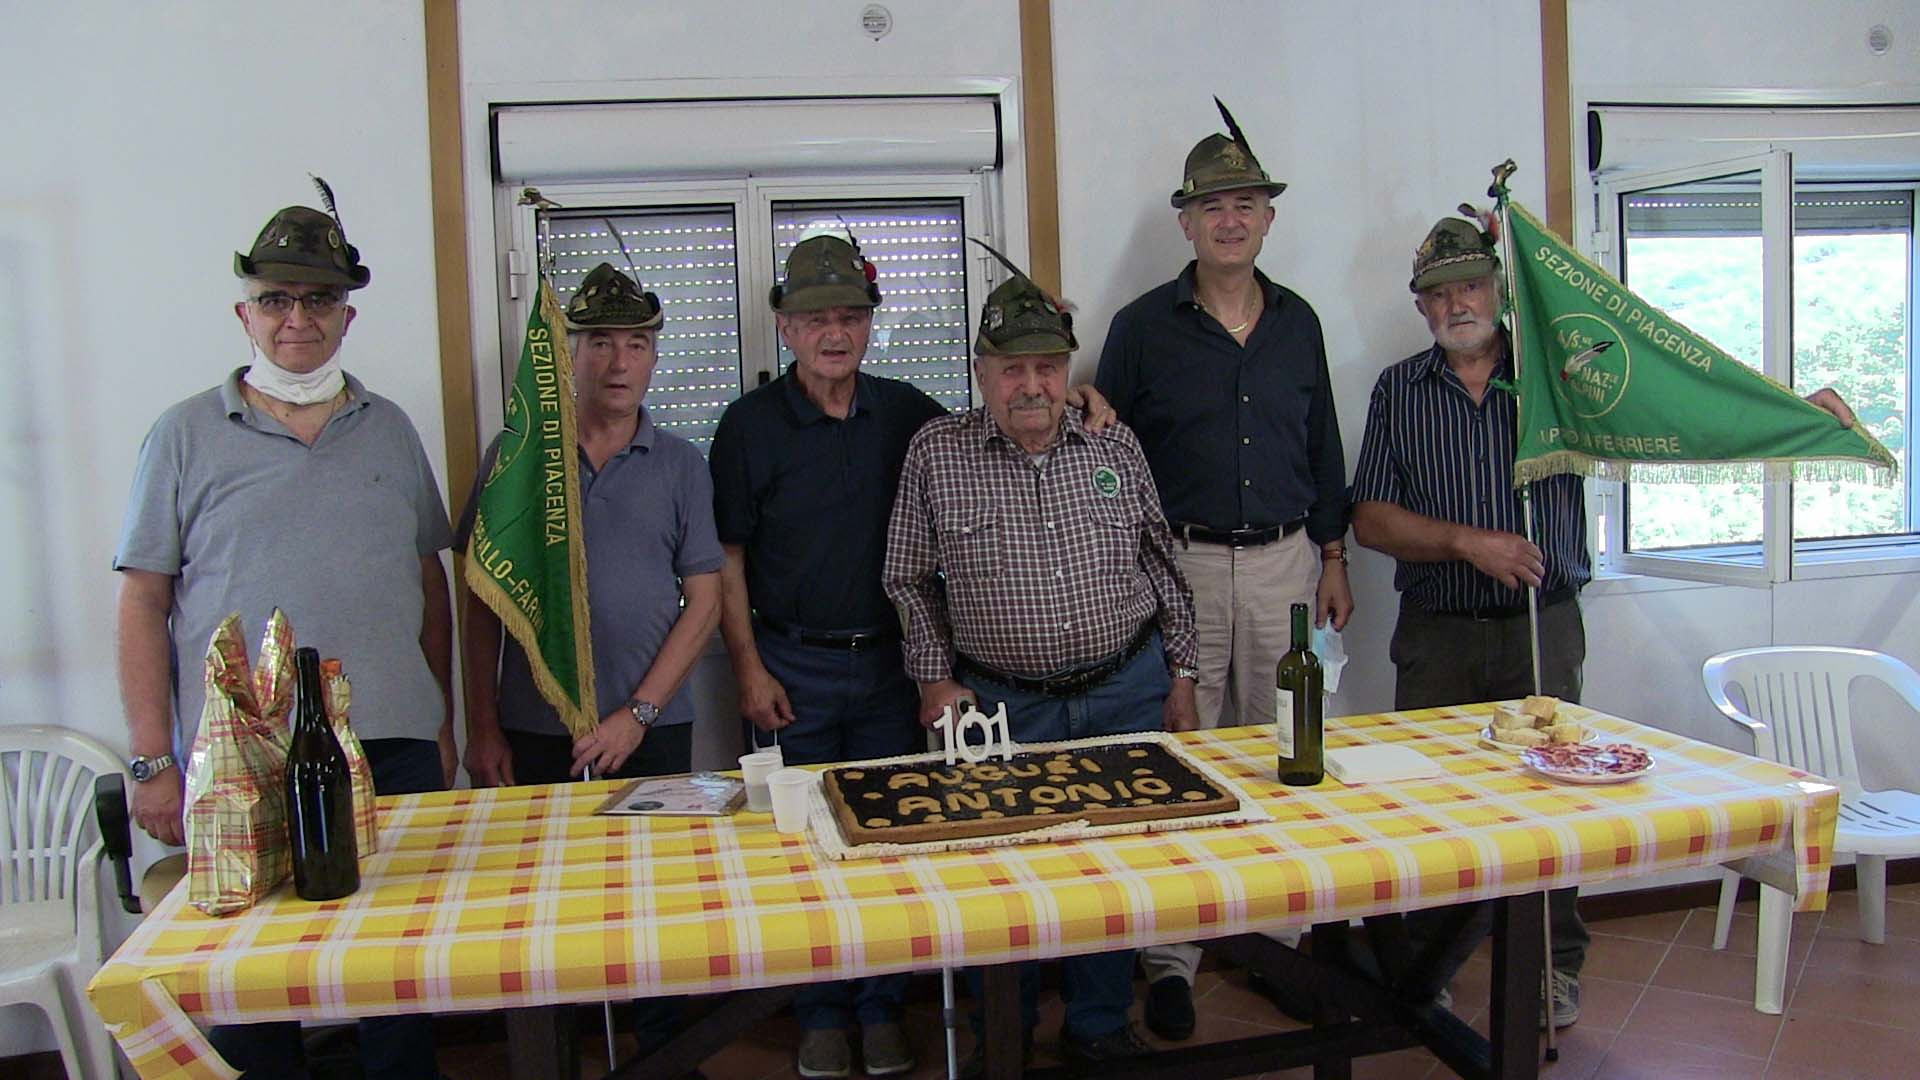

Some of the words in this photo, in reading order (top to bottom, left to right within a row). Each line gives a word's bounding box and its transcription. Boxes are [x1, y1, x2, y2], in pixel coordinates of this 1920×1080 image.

[1535, 246, 1608, 304] SEZIONE
[1605, 294, 1628, 317] DI
[1626, 308, 1713, 373] PIACENZA
[528, 328, 558, 413] SEZIONE
[543, 420, 561, 439] DI
[1594, 433, 1681, 454] FERRIERE
[544, 447, 567, 547] PIACENZA
[933, 701, 1013, 766] 101
[897, 777, 1172, 816] ANTONIO
